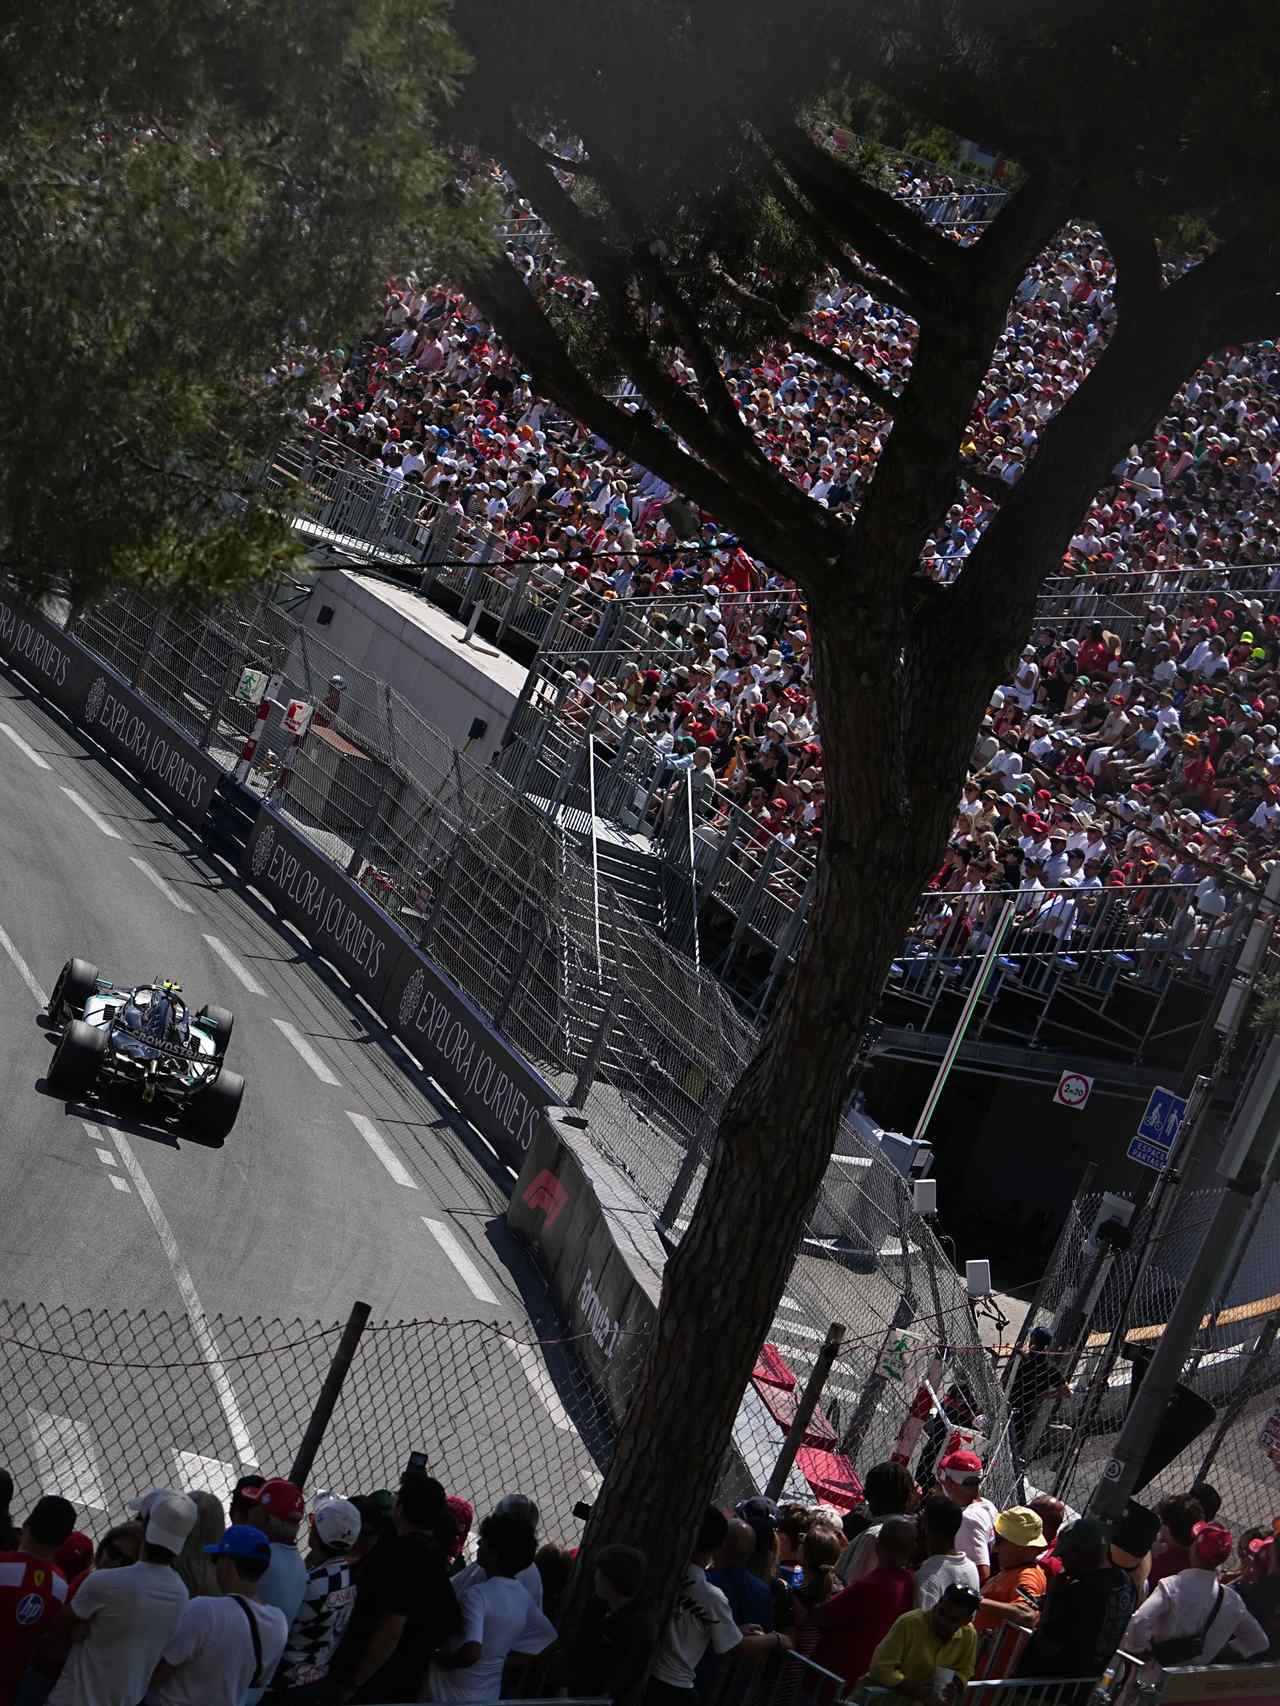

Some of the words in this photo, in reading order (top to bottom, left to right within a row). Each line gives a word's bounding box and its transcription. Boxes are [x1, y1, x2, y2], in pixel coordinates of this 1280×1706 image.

[9, 619, 71, 686] JOURNEYS
[99, 693, 152, 761] EXPLORA
[144, 735, 207, 808] JOURNEYS
[267, 843, 327, 921] EXPLORA
[318, 892, 386, 979] JOURNEYS
[415, 991, 476, 1081] EXPLORA
[464, 1050, 540, 1150] JOURNEYS
